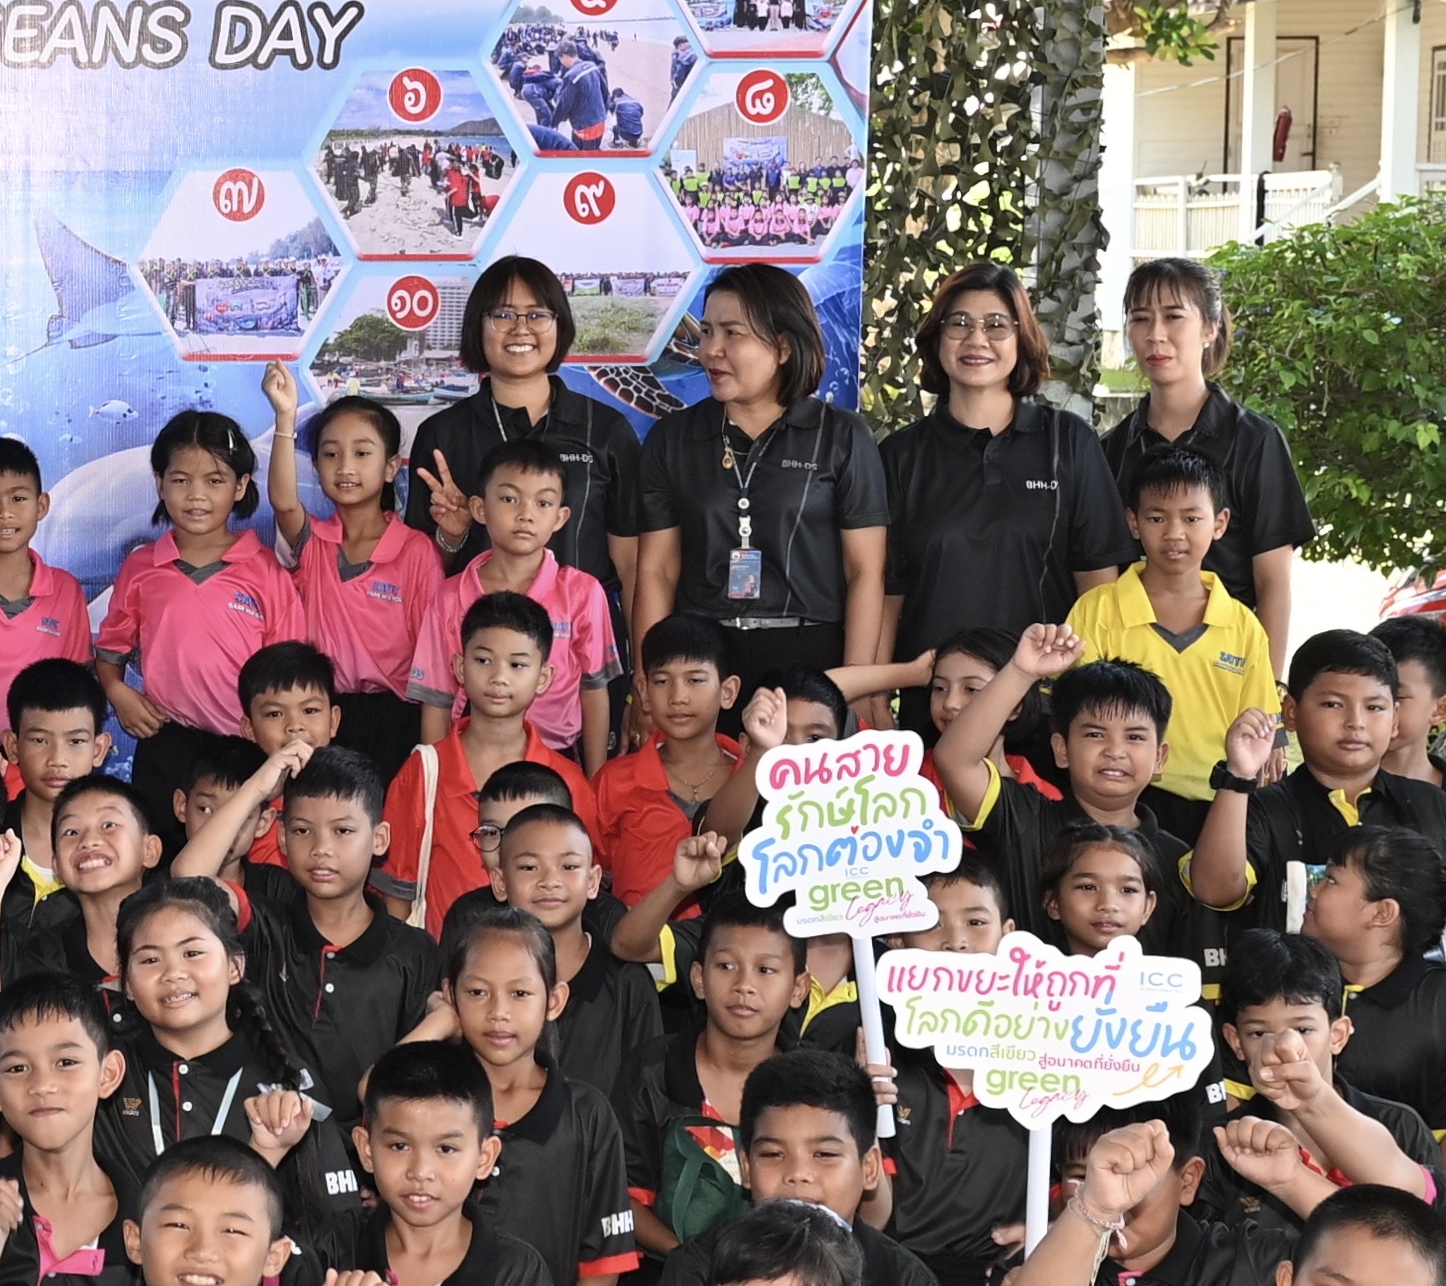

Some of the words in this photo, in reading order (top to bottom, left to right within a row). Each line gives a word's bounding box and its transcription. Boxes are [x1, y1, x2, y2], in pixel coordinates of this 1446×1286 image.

[209, 0, 364, 68] DAY
[746, 77, 778, 114] ๘
[219, 179, 260, 212] ๗
[572, 179, 609, 218] ๙
[389, 287, 436, 318] ๑๐
[769, 742, 910, 790] คนสาย
[775, 775, 927, 841] รักษ์โลก
[845, 866, 869, 877] ICC
[808, 876, 905, 912] green
[887, 947, 1127, 1013] แยกขยะให้ถูกที่
[1139, 971, 1183, 988] ICC
[905, 992, 1197, 1062] โลกดีอย่างยั่งยืน
[946, 1044, 1037, 1062] มรดกสีเขียว
[1038, 1052, 1141, 1074] สู่อนาคตที่ยั่งยืน
[985, 1068, 1081, 1097] green
